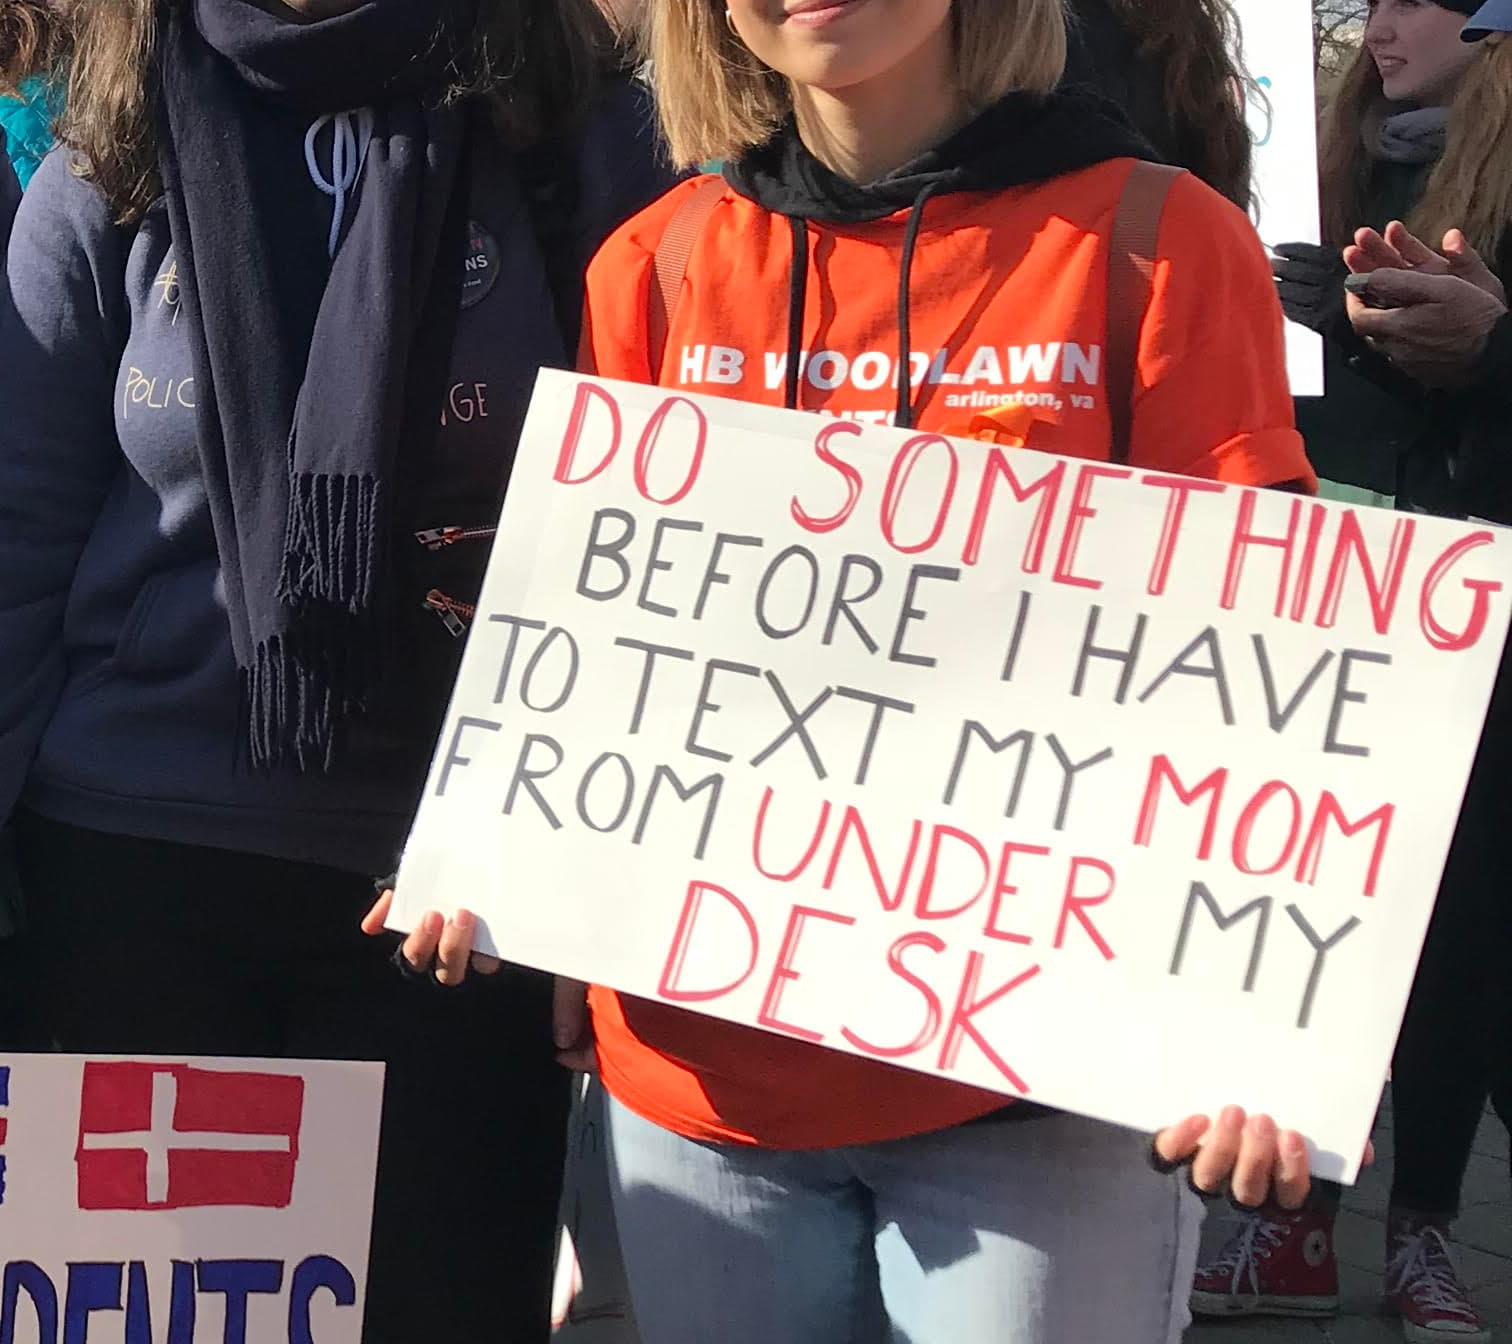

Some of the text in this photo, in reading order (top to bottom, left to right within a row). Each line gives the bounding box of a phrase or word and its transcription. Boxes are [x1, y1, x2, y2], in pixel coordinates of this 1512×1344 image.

[463, 254, 489, 272] NS
[679, 344, 746, 385] HB
[123, 366, 196, 420] POLIC
[552, 382, 1503, 653] DO SOMETHING
[576, 508, 1392, 758] BEFORE I HAVE
[486, 614, 1397, 898] TO TEXT MY MOM
[435, 716, 1360, 1031] FROM UNDER MY
[656, 879, 1044, 1096] DESK
